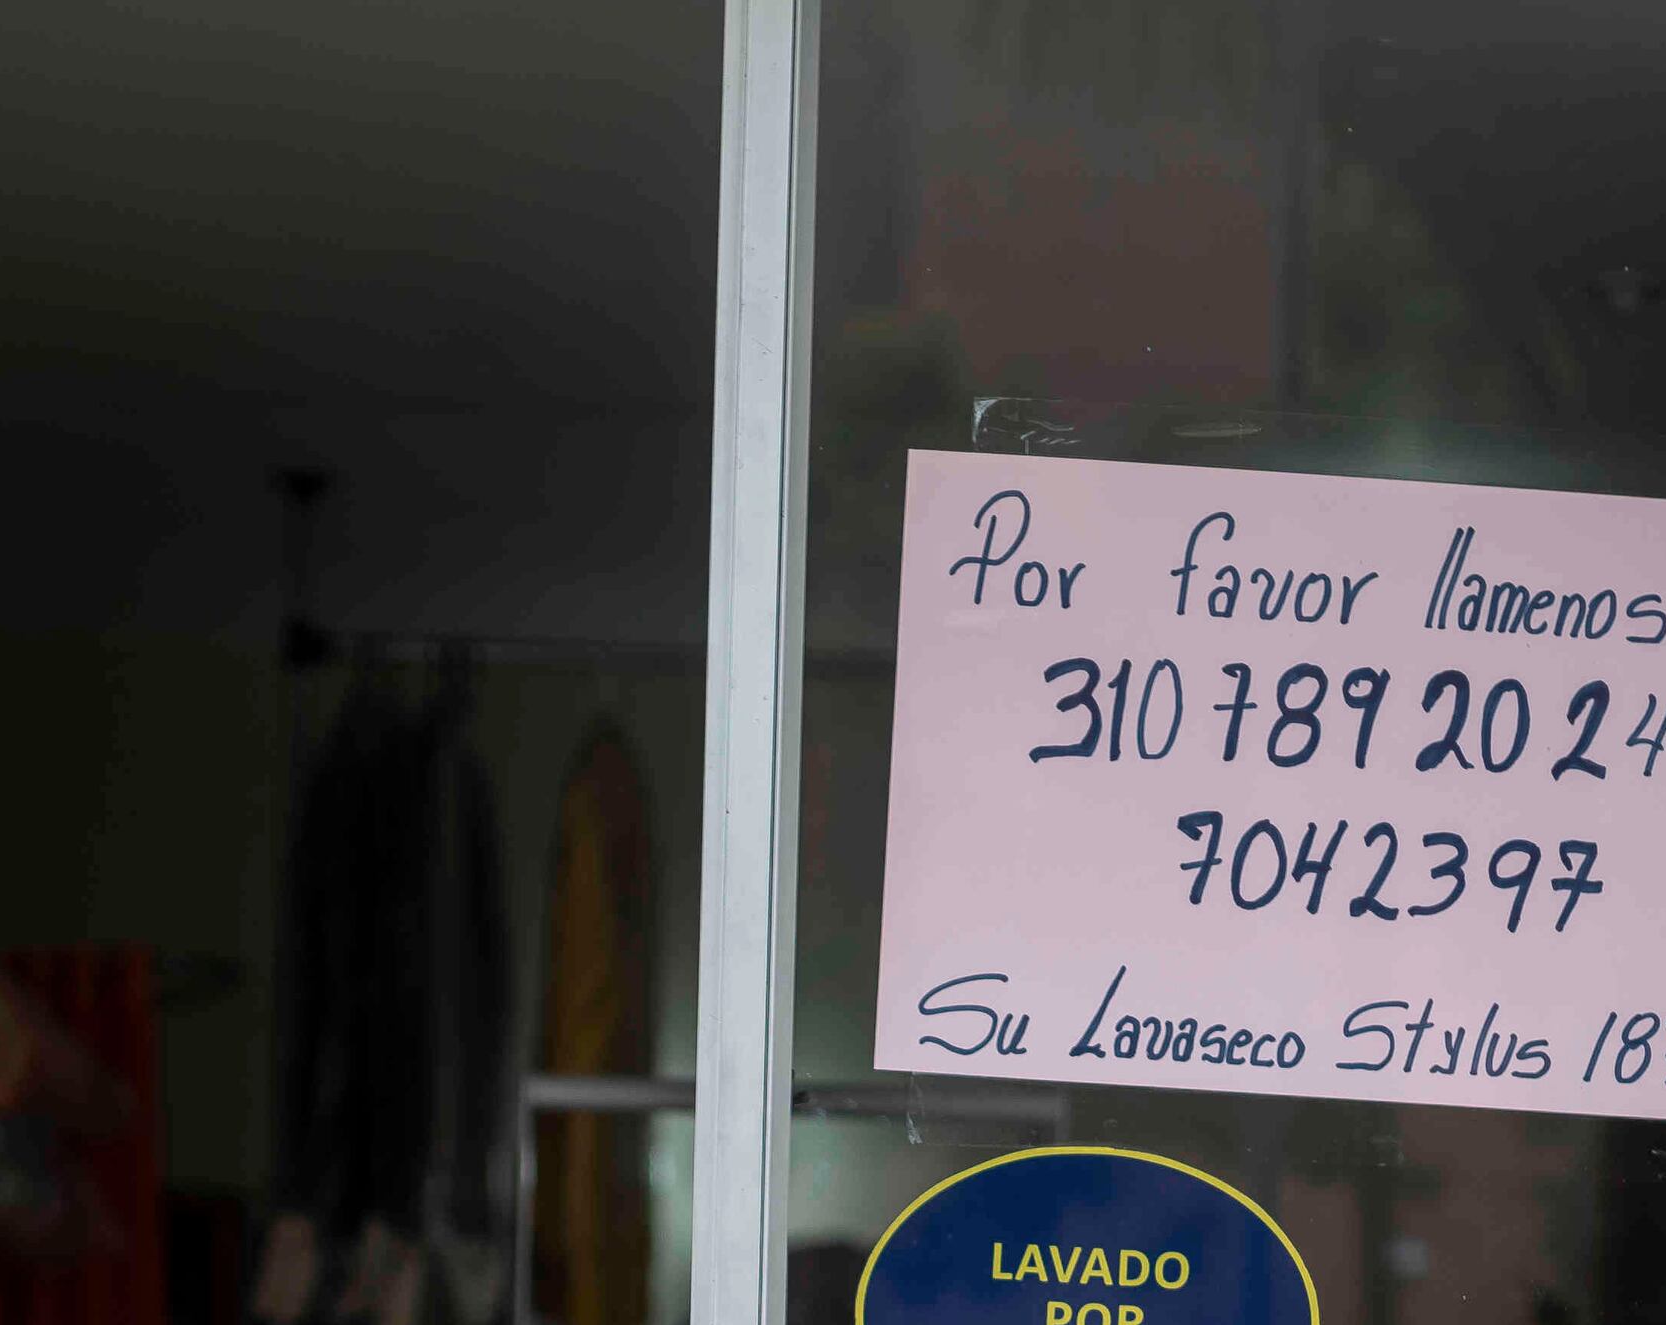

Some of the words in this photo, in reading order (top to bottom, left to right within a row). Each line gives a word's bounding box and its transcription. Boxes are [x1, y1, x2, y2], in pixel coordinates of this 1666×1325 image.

[949, 490, 1086, 609] Por
[1170, 512, 1379, 625] favor
[1029, 658, 1183, 763] 310
[1177, 811, 1603, 933] 7042397
[918, 974, 1029, 1055] Su
[1069, 966, 1305, 1068] Lavaseco
[1336, 999, 1551, 1079] Stylus
[993, 1243, 1189, 1289] LAVADO
